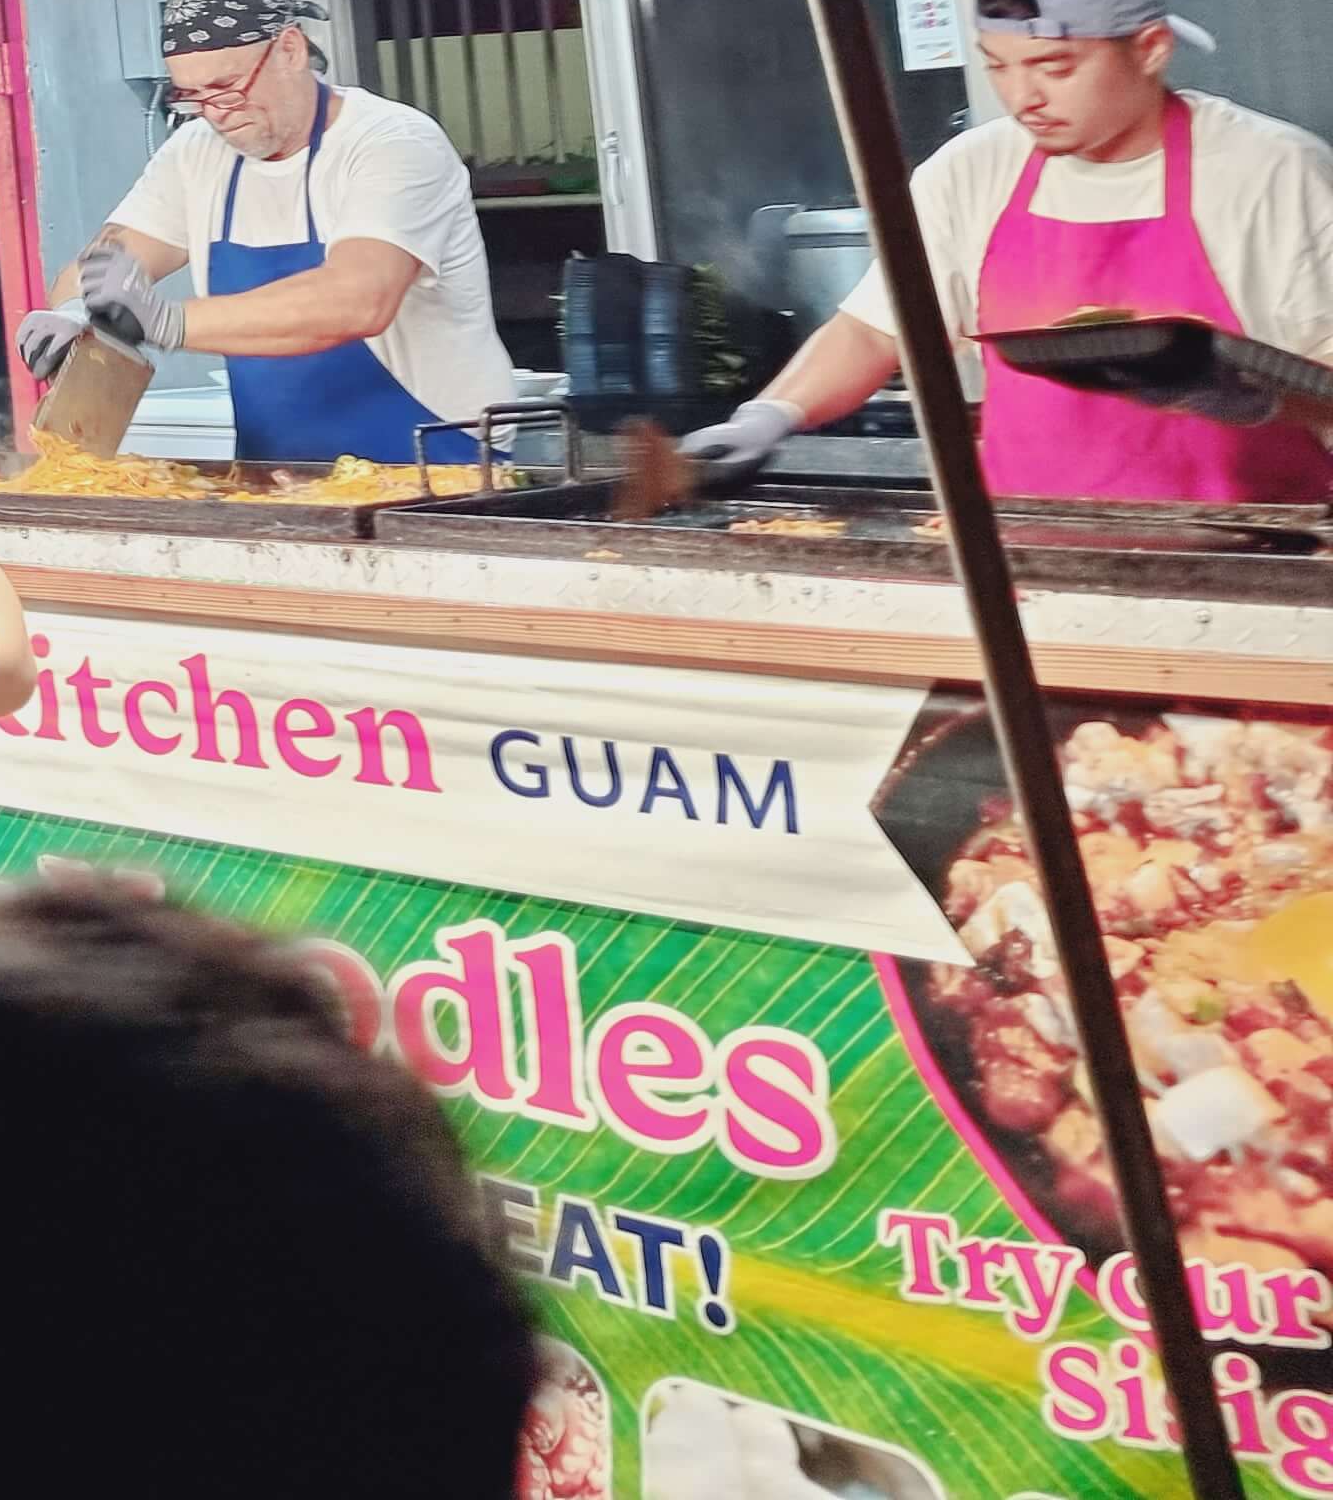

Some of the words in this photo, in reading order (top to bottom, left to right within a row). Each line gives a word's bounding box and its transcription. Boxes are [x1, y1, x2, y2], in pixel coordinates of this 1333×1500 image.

[486, 728, 801, 835] GUAM
[886, 1213, 1077, 1336] Try
[1047, 1344, 1333, 1492] Siig
